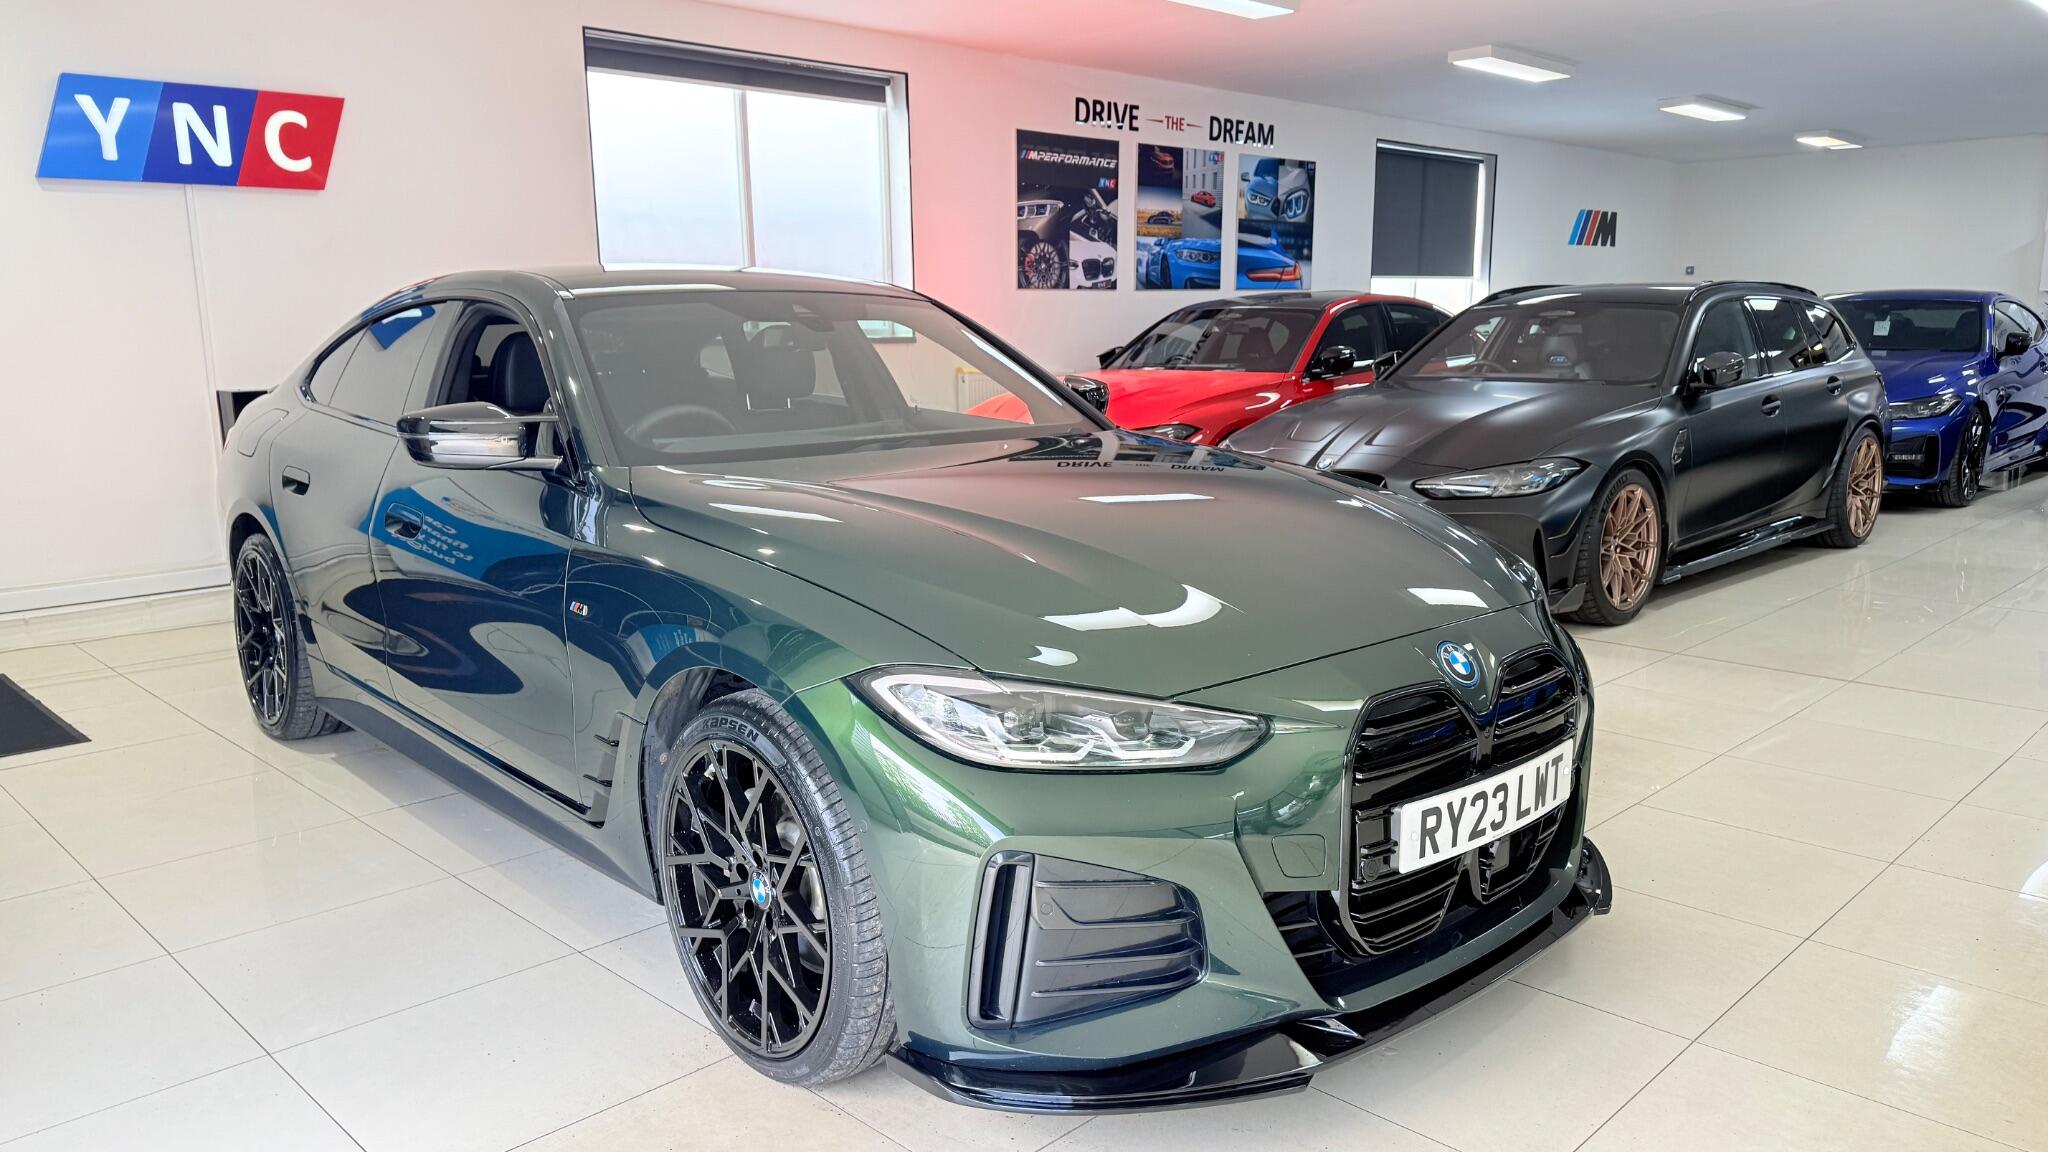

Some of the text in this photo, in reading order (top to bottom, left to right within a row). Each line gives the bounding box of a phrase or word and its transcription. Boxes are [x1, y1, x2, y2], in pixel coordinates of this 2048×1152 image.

[74, 94, 312, 172] YNC
[1075, 97, 1274, 148] DRIVE THE DREAM
[1419, 753, 1564, 860] RY23 LWT
